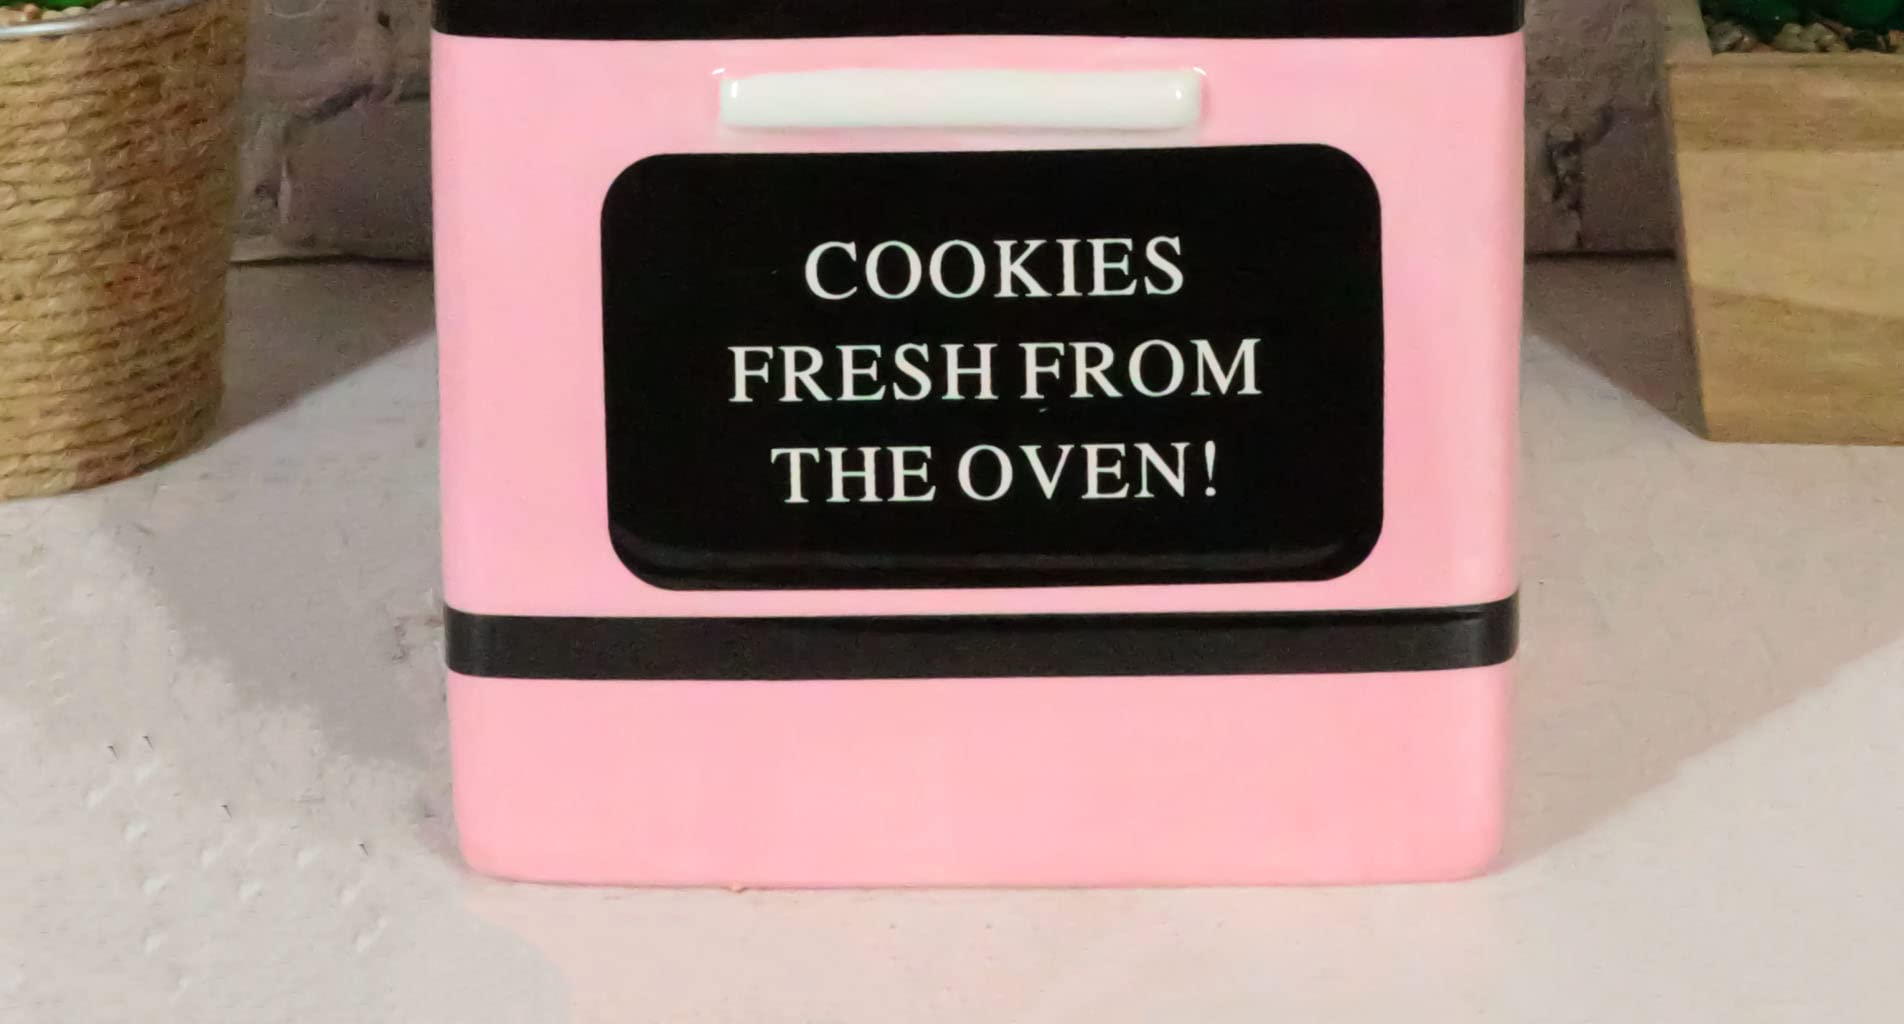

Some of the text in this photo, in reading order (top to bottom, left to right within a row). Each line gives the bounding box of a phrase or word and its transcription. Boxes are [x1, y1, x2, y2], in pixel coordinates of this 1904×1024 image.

[804, 235, 1185, 301] COOKIES
[727, 338, 1263, 402] FRESH FROM
[771, 440, 1218, 504] THE OVEN!
